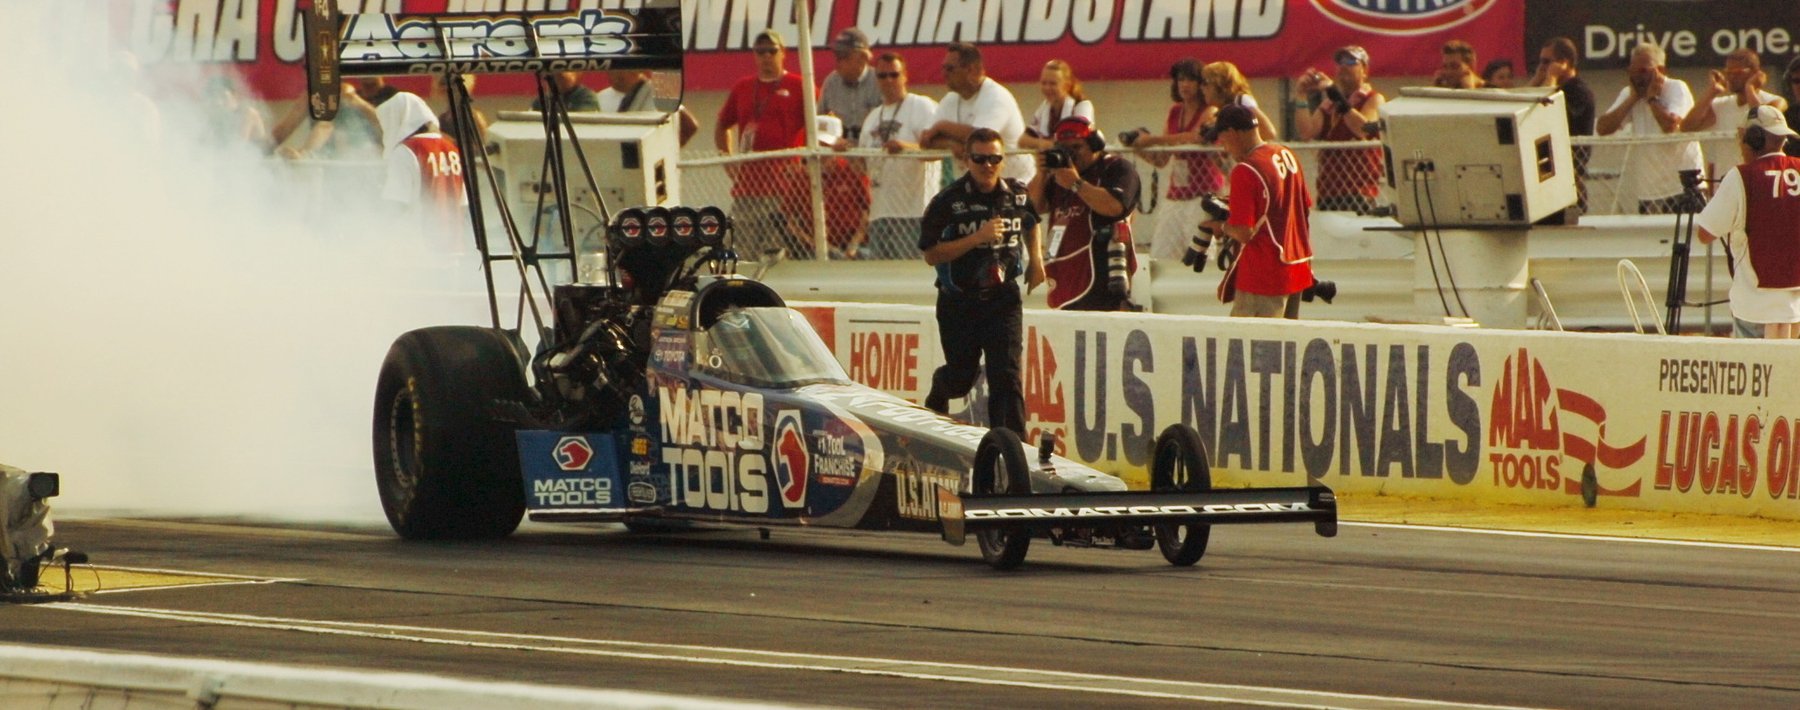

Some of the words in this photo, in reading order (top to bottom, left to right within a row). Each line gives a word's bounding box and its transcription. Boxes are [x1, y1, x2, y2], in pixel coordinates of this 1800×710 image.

[1584, 24, 1697, 59] Drive
[408, 59, 612, 74] GOMATCOCOM
[427, 150, 461, 177] 148
[1272, 149, 1298, 180] 60
[1764, 168, 1800, 198] 79
[958, 217, 1022, 236] MACO
[851, 331, 919, 391] HOME
[1659, 359, 1747, 396] PRESENTED
[1752, 363, 1773, 398] BY
[1074, 329, 1156, 467] U.S
[1181, 337, 1481, 486] NATIONALS
[1489, 347, 1560, 450] MAC
[659, 386, 764, 450] MATCO
[1489, 453, 1560, 491] TOOLS
[1654, 410, 1761, 499] LUCAS
[1766, 415, 1800, 501] OI
[534, 478, 612, 492] MATCO
[662, 447, 769, 513] TOOLS
[534, 491, 612, 506] TOOLS
[963, 503, 1312, 519] GOMATCOCOM
